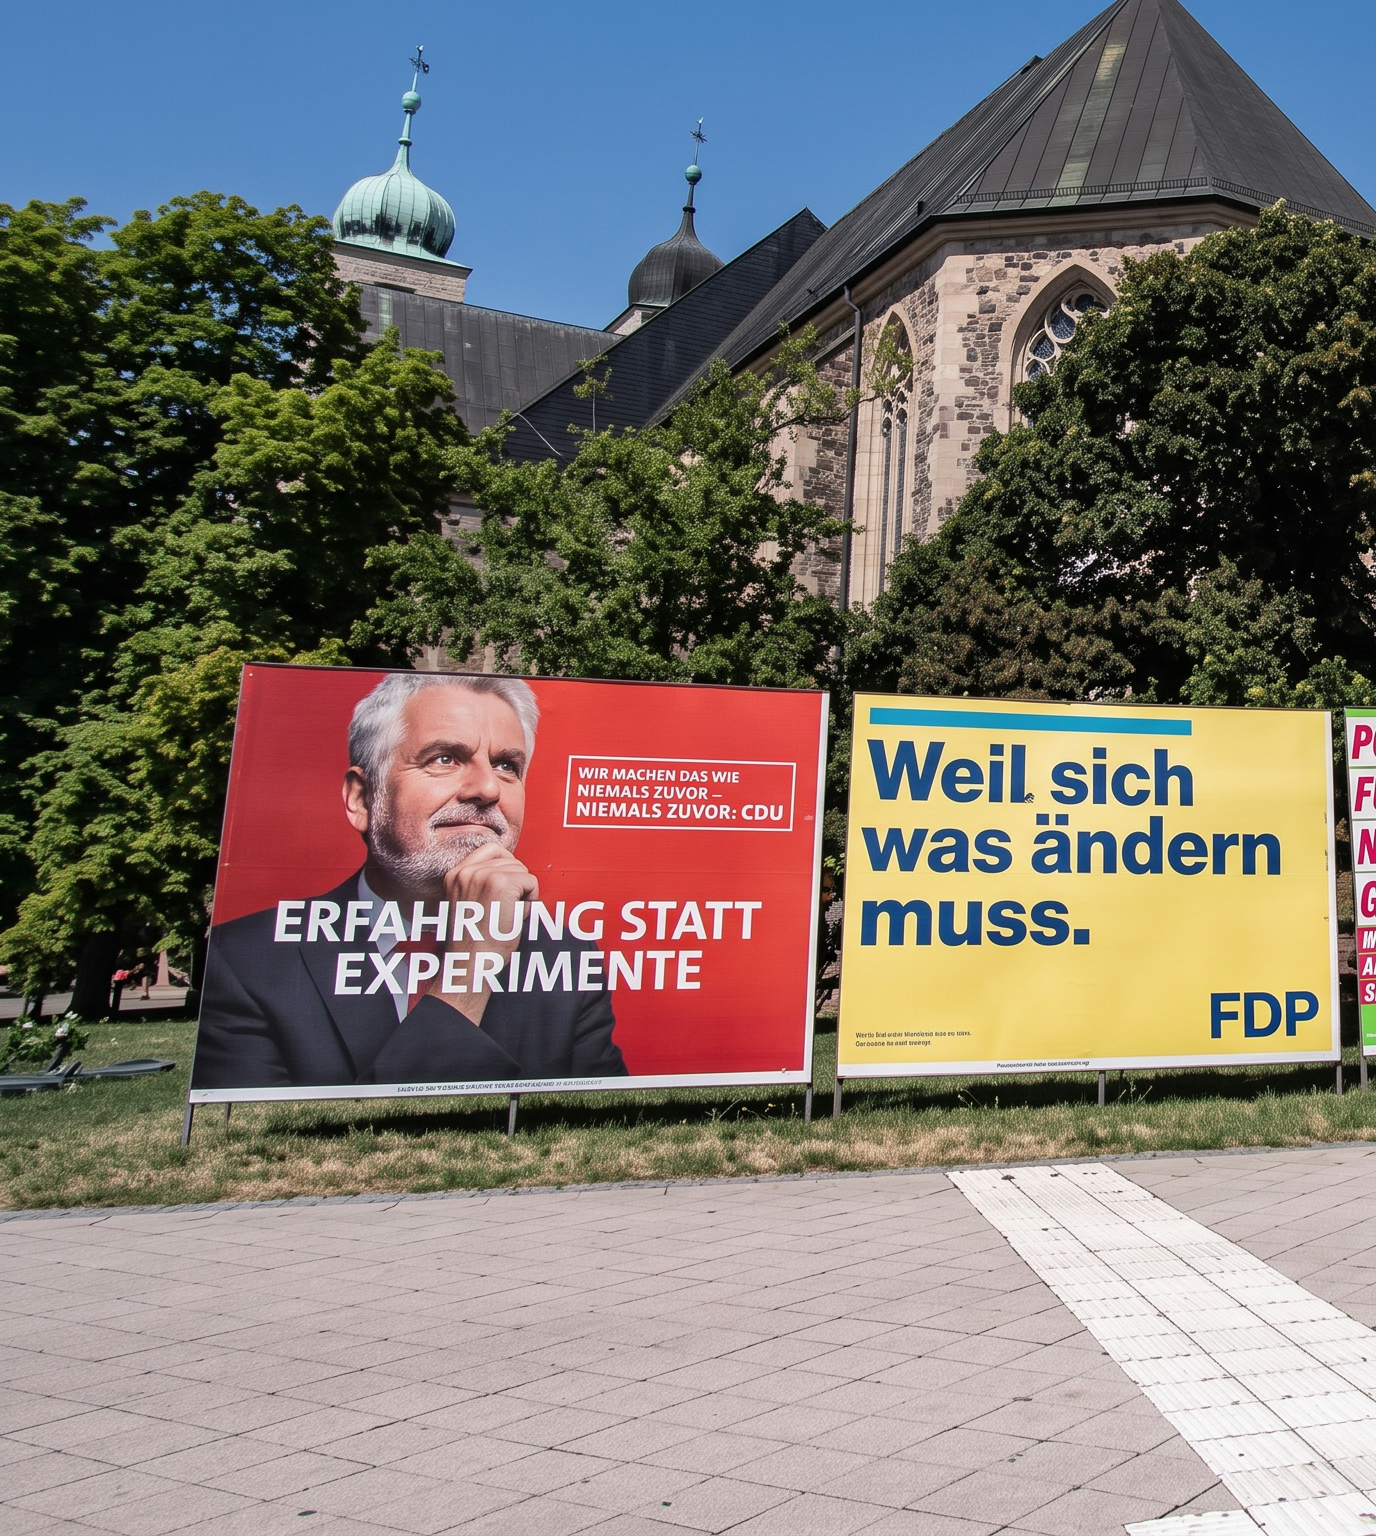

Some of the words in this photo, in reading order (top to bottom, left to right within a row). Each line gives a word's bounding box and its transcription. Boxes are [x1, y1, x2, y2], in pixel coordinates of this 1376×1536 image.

[577, 784, 650, 799] NIEMALS
[653, 786, 708, 800] ZUVOR
[578, 767, 608, 780] WIR
[612, 768, 676, 782] MACHEN
[680, 770, 708, 783] DAS
[712, 771, 740, 783] WIE
[867, 739, 1027, 805] Weil
[1050, 746, 1194, 807] sich
[576, 802, 662, 819] NIEMALS
[666, 803, 737, 820] ZUVOR:
[741, 804, 784, 821] CDU
[861, 826, 1013, 873] was
[1031, 813, 1281, 877] ändern
[274, 900, 604, 943] ERFAHRUNG
[620, 900, 763, 941] STATT
[860, 898, 1091, 947] muss.
[334, 950, 703, 996] EXPERIMENTE
[1209, 990, 1319, 1040] FDP
